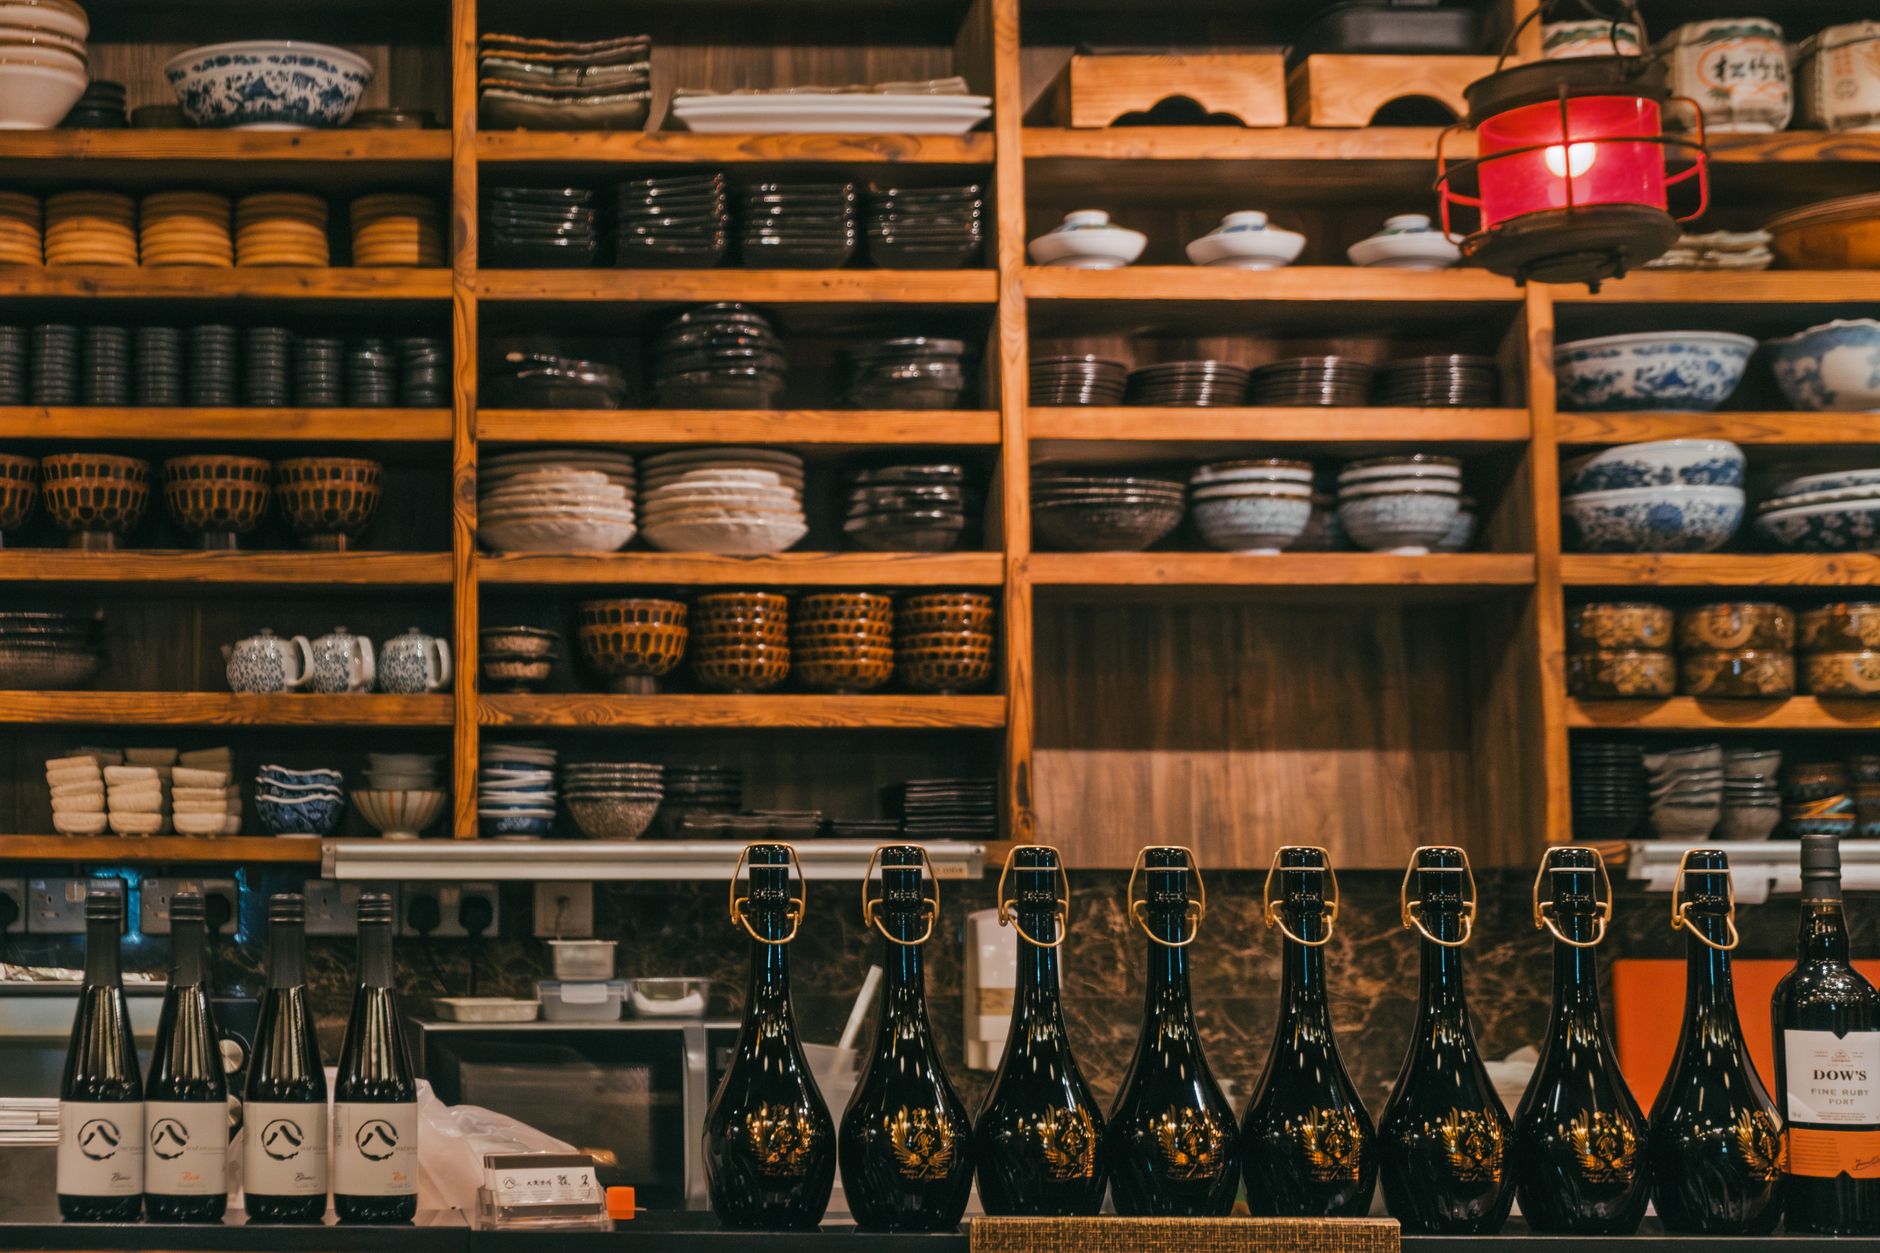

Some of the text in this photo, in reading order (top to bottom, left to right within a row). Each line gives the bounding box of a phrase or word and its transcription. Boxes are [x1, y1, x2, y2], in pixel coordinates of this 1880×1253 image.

[1813, 1069, 1868, 1081] DOW'S
[1810, 1087, 1870, 1097] FINE RUBY
[1828, 1097, 1856, 1105] PORT
